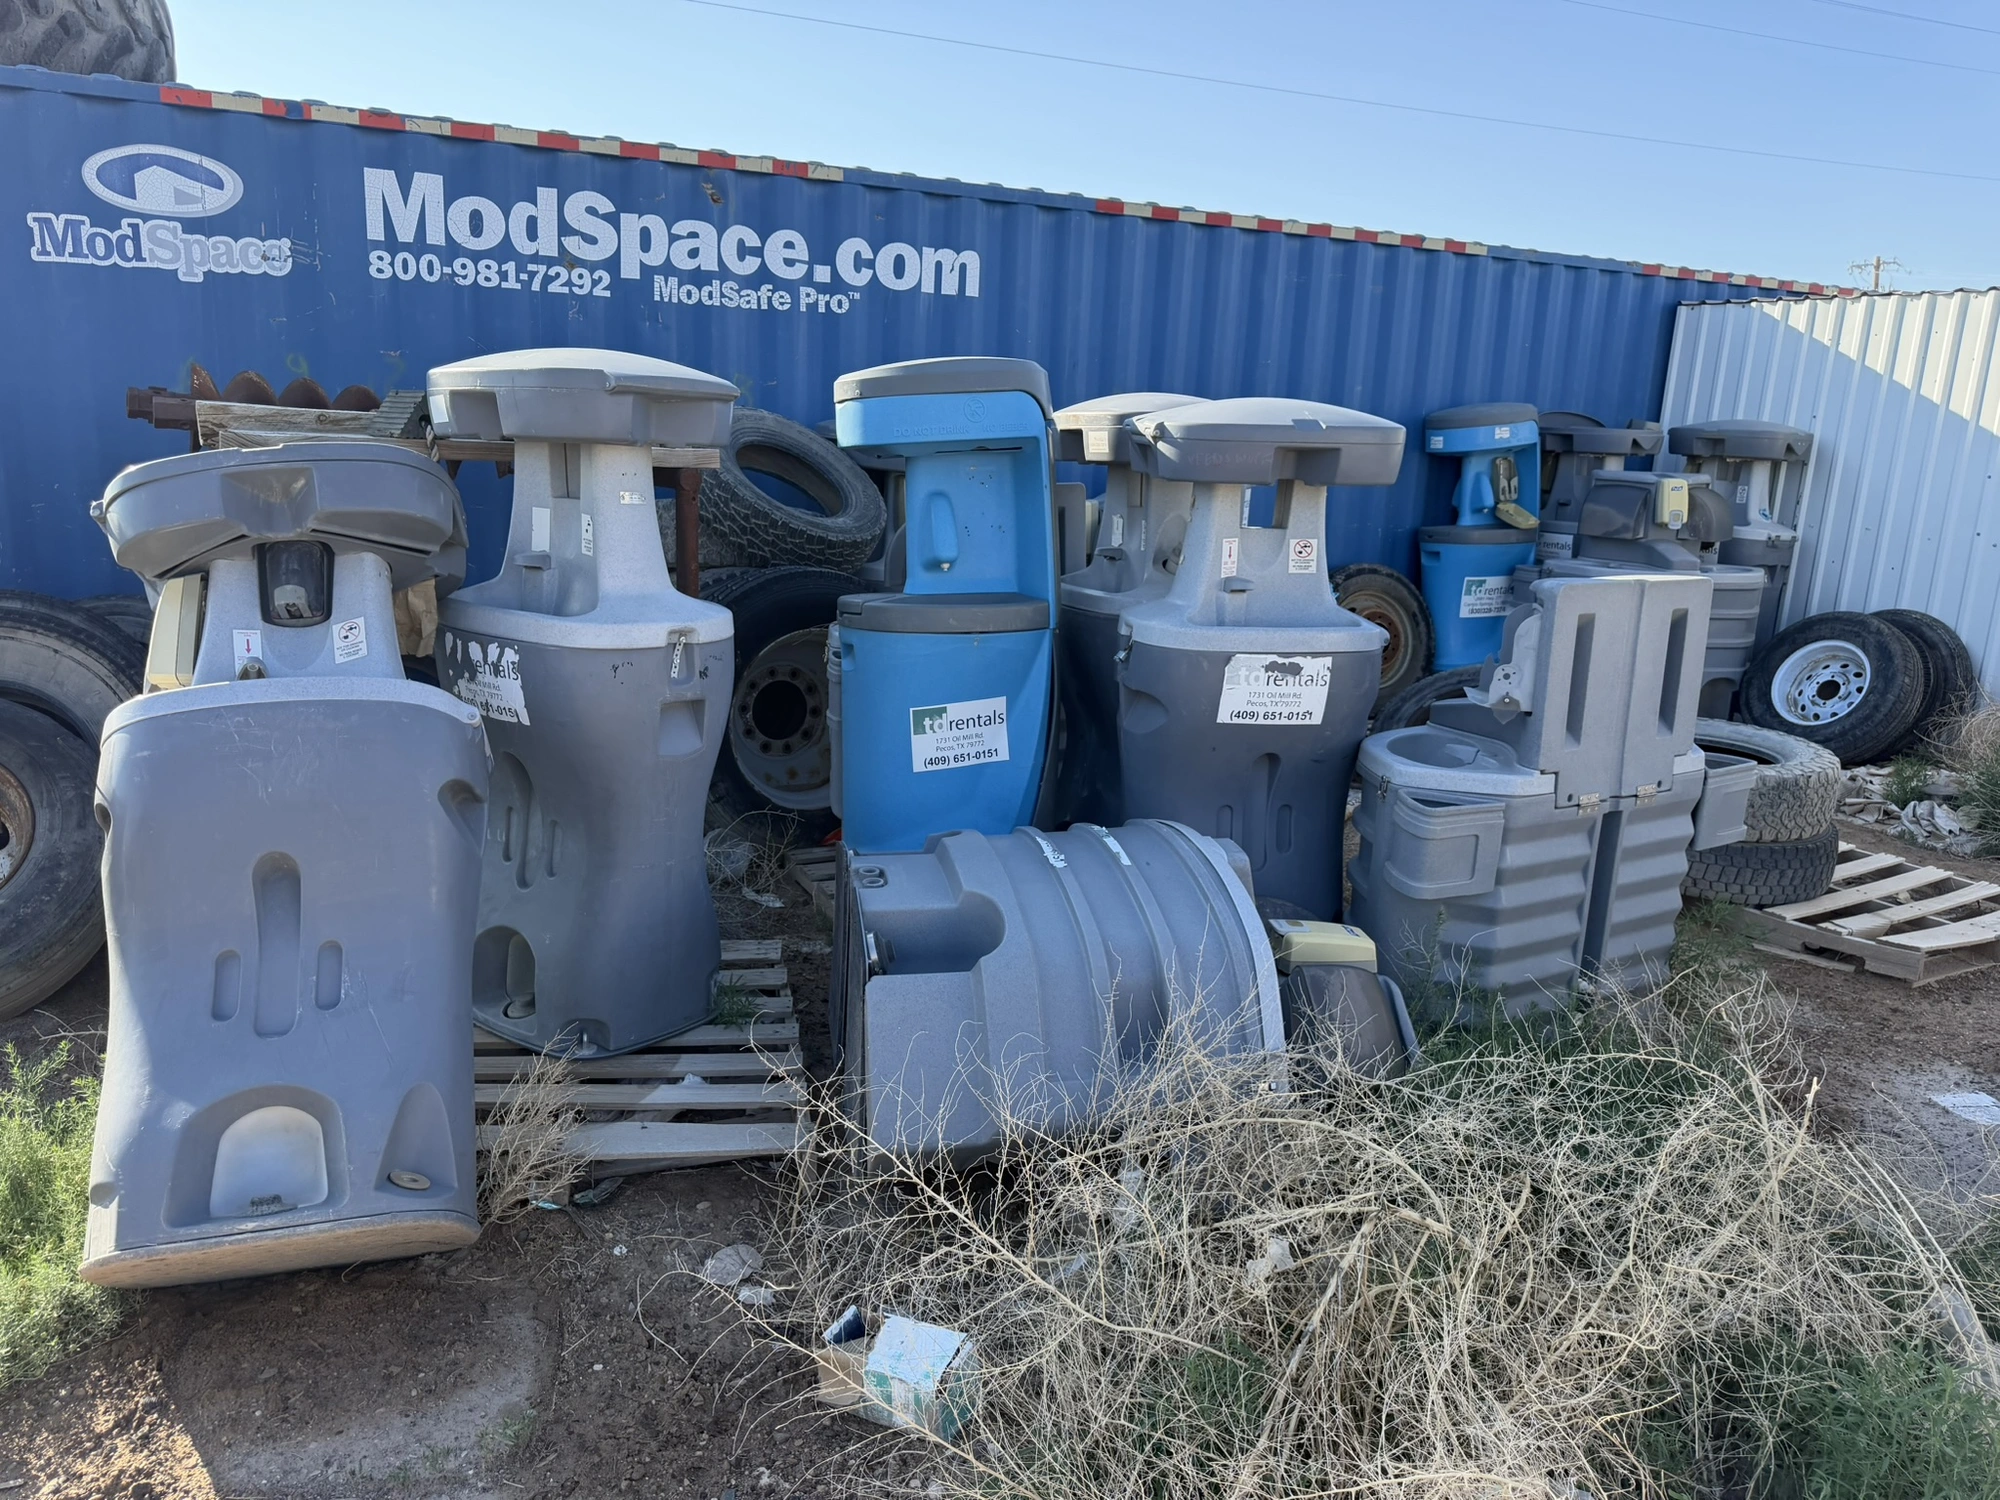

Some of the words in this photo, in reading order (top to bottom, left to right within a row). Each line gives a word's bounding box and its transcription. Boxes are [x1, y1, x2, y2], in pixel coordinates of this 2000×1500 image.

[364, 167, 981, 297] ModSpace.com
[368, 250, 611, 297] 800-981-7292
[653, 275, 792, 311] ModSafe
[1248, 691, 1265, 699] 1731
[1266, 691, 1277, 699] Oil
[1246, 699, 1268, 708] Pecos,
[1280, 700, 1301, 708] 79772
[1229, 709, 1259, 722] (409)
[1262, 710, 1313, 721] 651-0151
[935, 736, 950, 744] 1731
[962, 733, 973, 741] Mill
[957, 742, 965, 750] TX
[966, 739, 985, 749] 79772
[923, 755, 950, 769] (409)
[953, 748, 998, 764] 651-0151
